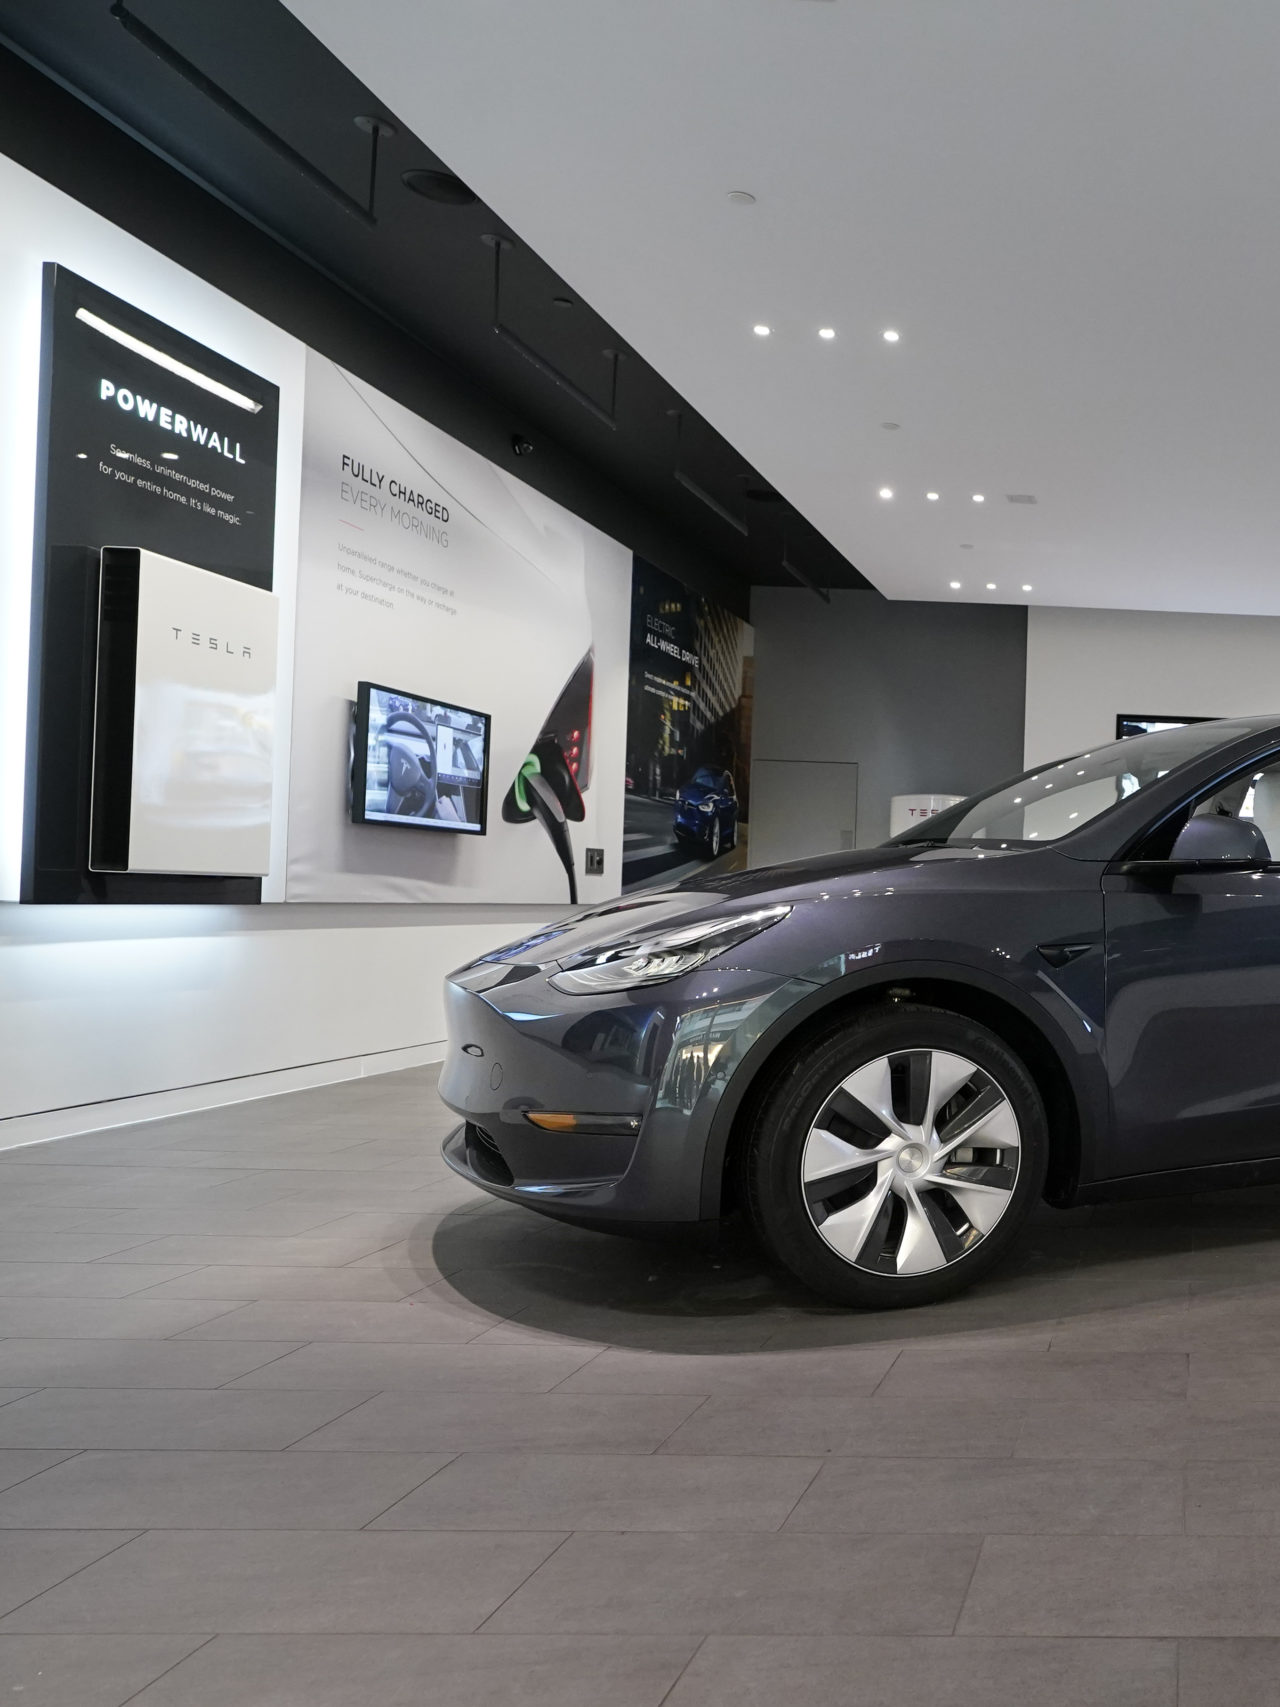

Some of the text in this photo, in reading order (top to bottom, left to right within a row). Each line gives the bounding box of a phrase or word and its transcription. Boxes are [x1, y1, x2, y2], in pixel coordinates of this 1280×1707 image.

[100, 378, 246, 465] POWERWALL
[99, 461, 242, 526] for your entire home. It's like magic.
[154, 463, 210, 493] uninterrupted
[210, 487, 235, 503] power
[341, 453, 450, 523] FULLY CHARGED
[340, 481, 449, 549] EVERY MORNING
[378, 559, 395, 573] range
[172, 627, 252, 659] TESLA
[646, 614, 676, 640] ELECTRIC
[646, 633, 700, 668] ALL-WHEEL DRIVE
